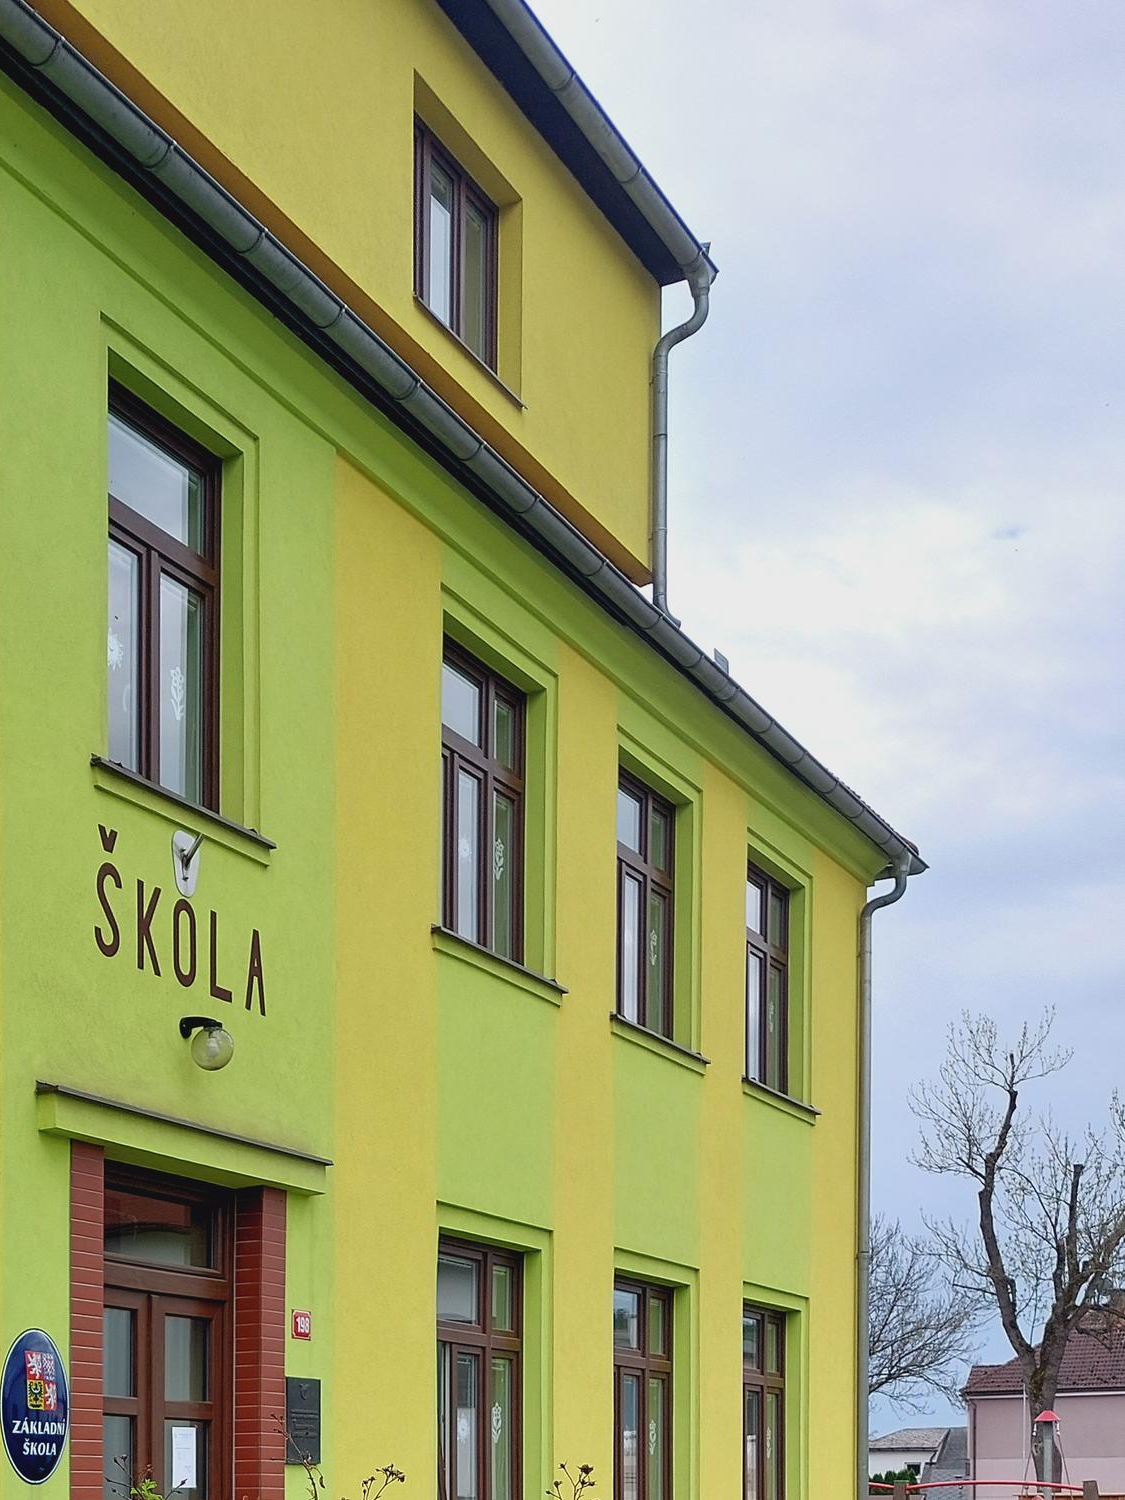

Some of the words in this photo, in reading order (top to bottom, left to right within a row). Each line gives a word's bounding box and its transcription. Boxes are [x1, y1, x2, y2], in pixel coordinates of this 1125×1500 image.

[94, 824, 266, 1016] ŠKOLA
[11, 1417, 65, 1435] ZÁKLADNÍ
[22, 1438, 57, 1456] ŠKOLA
